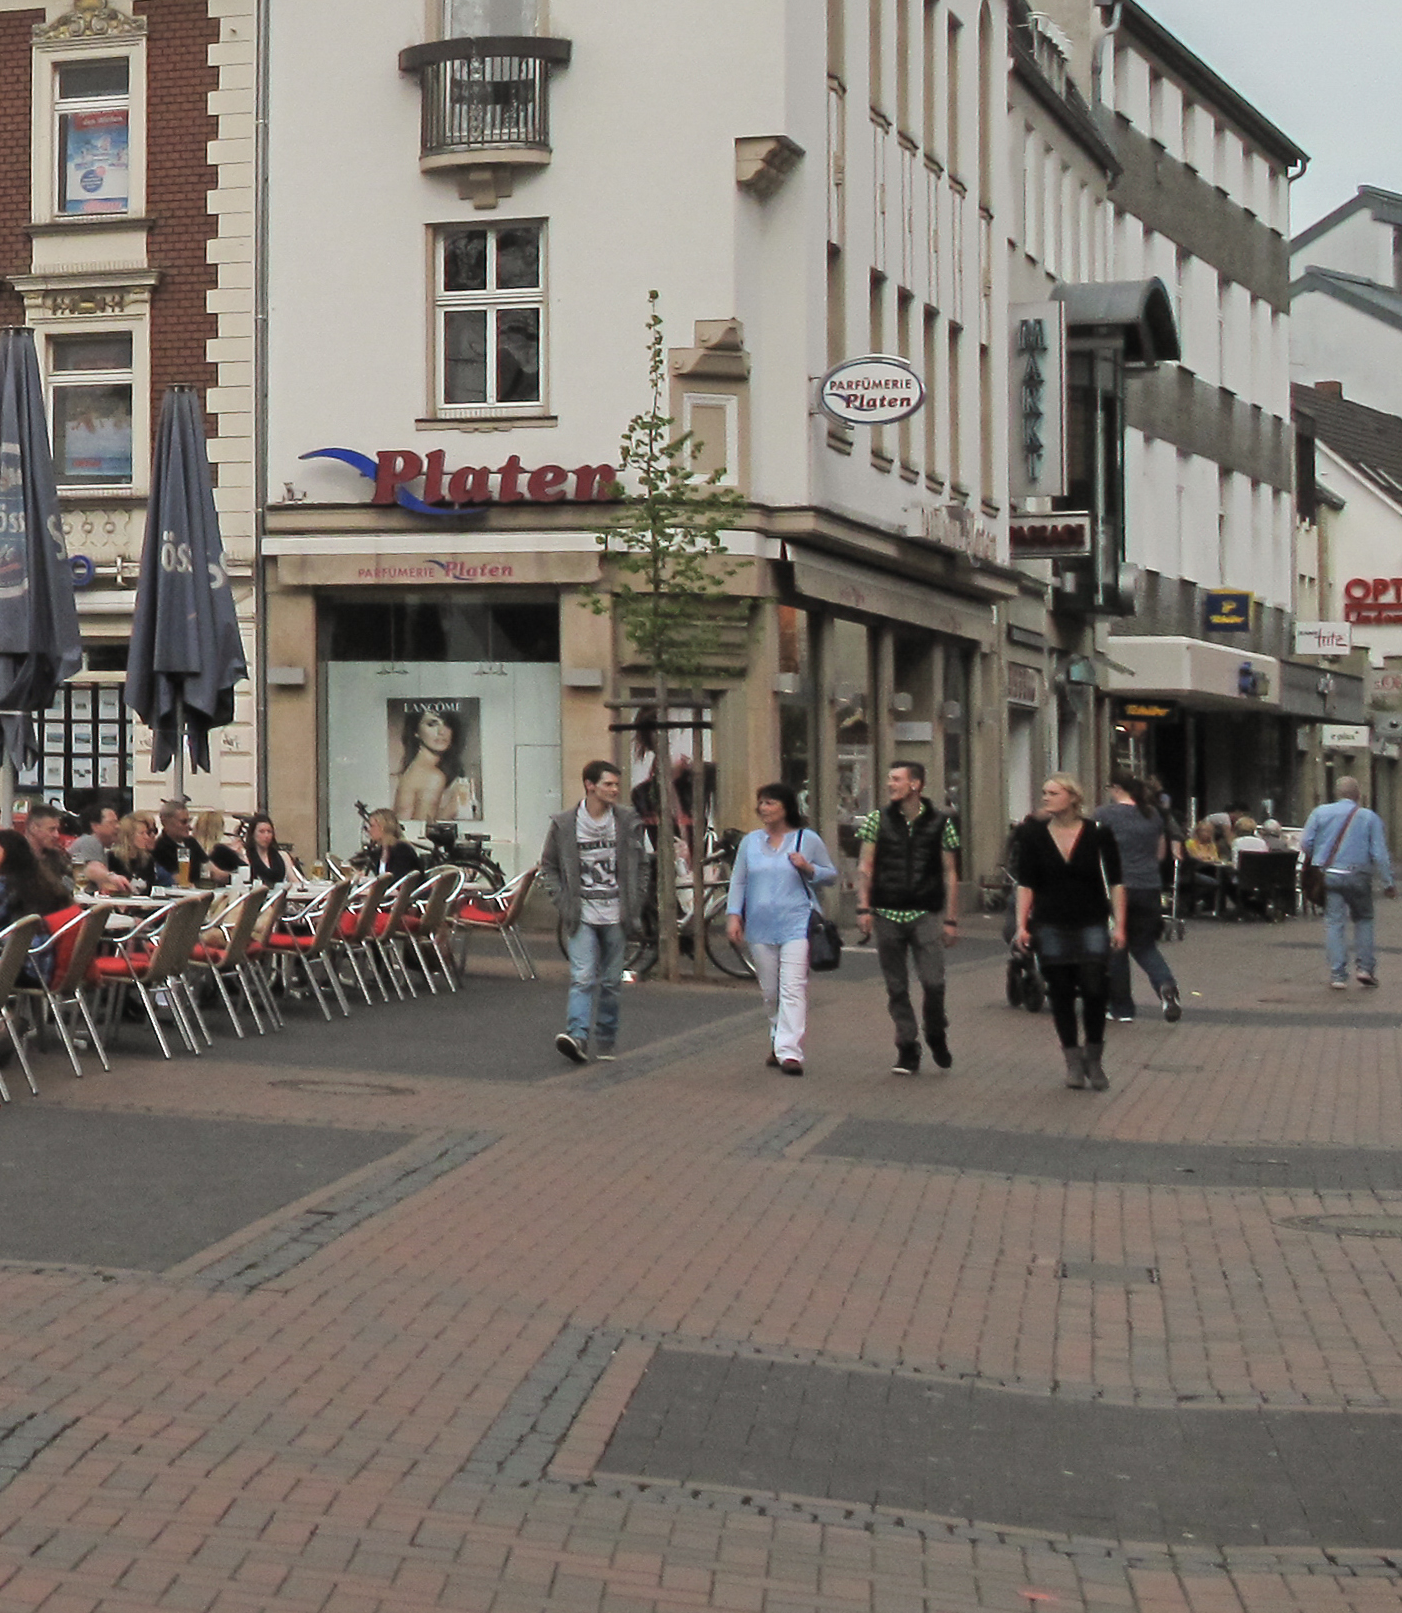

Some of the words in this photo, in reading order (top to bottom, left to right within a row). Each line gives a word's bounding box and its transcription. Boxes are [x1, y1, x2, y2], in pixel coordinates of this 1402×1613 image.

[829, 377, 912, 390] PARFÜMERIE
[845, 394, 912, 409] Platen
[371, 449, 617, 505] Platen
[445, 561, 514, 578] Platen
[403, 700, 461, 714] LANCÔME
